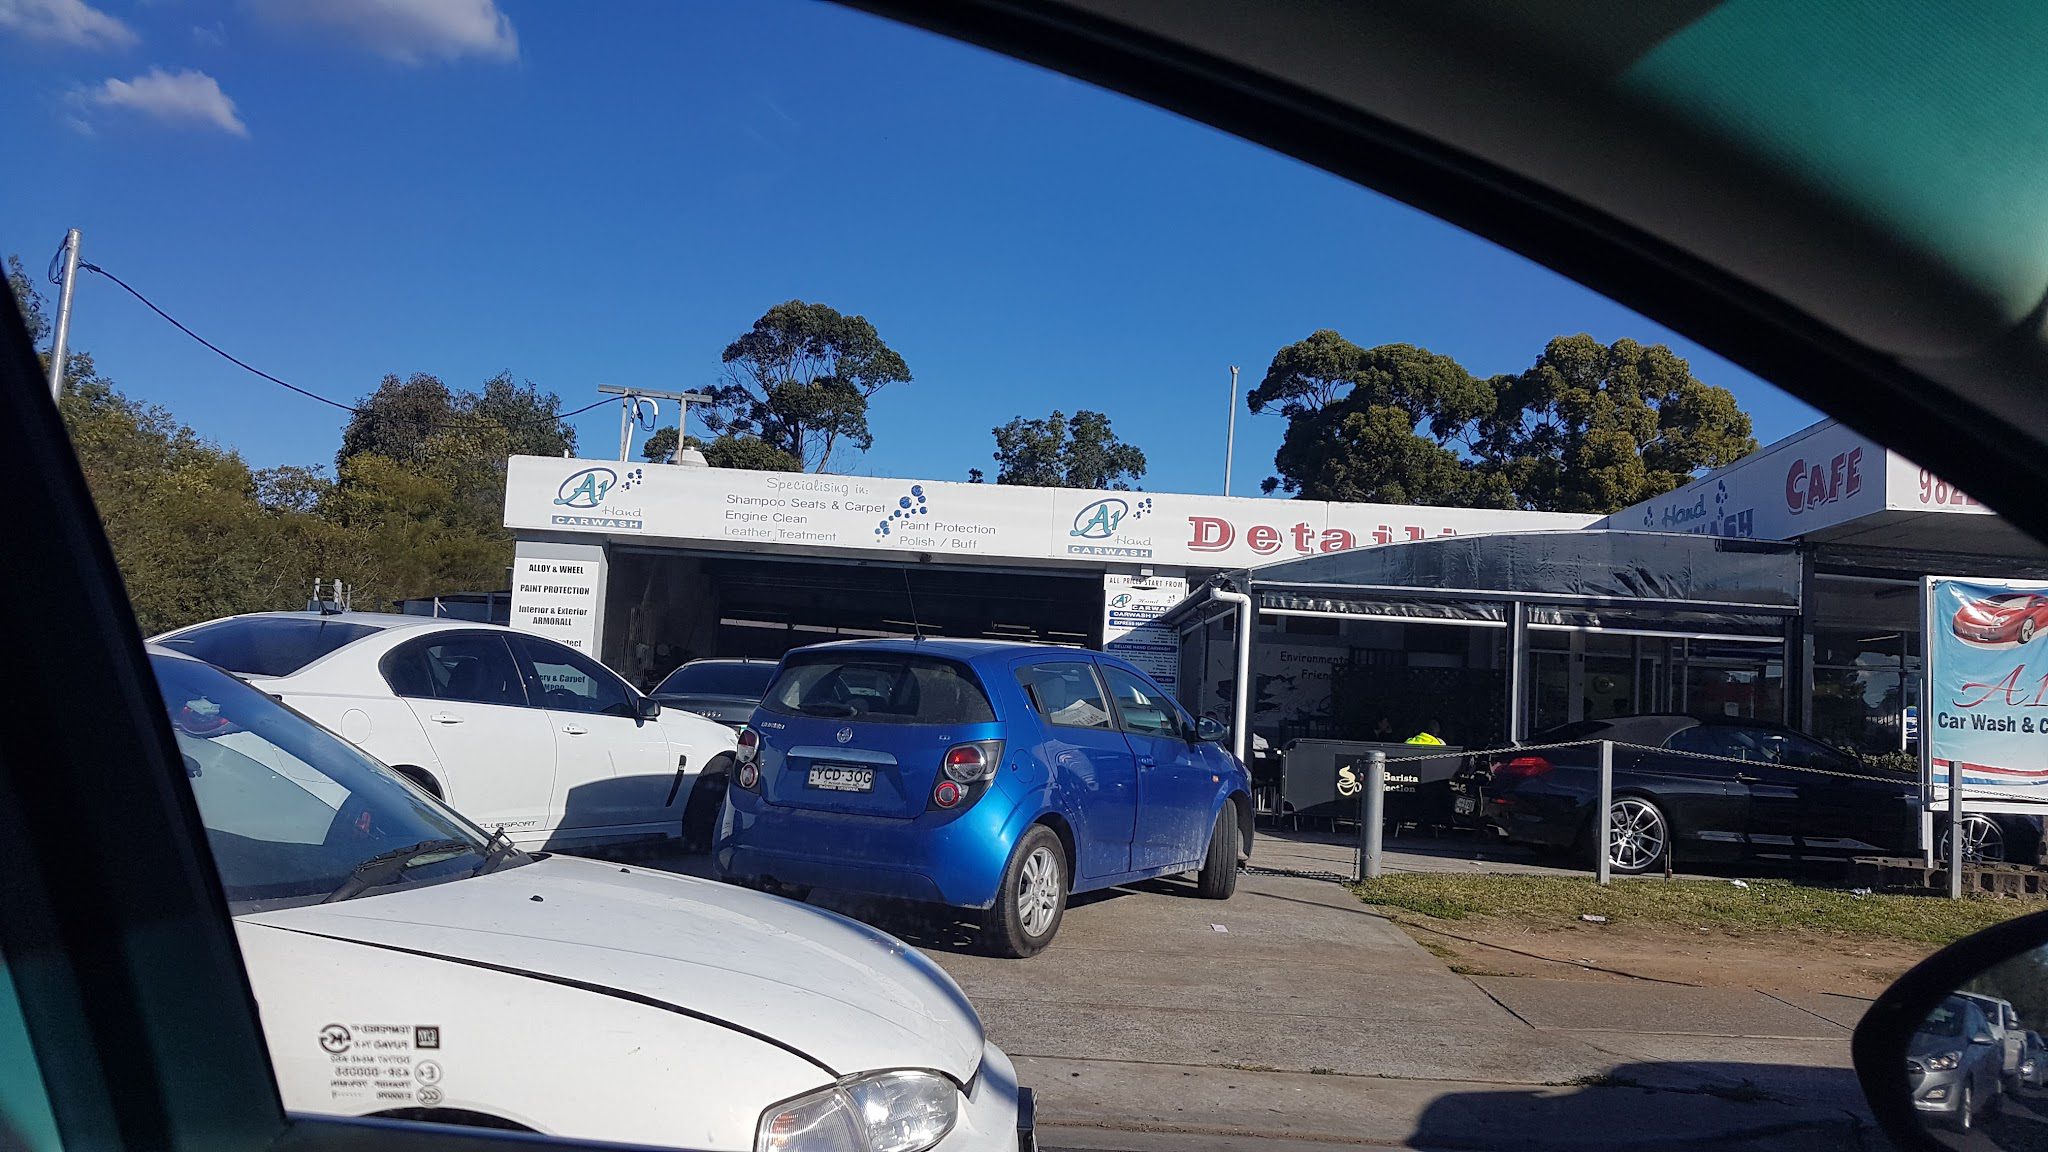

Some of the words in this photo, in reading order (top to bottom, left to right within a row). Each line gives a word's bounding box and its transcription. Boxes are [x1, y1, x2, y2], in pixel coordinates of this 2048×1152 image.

[766, 477, 849, 497] Specialising
[1786, 446, 1864, 515] CAFE
[1919, 467, 1980, 506] 982
[553, 472, 609, 506] A1
[726, 494, 786, 507] Shampoo
[790, 498, 826, 509] Seats
[831, 500, 840, 510] &
[844, 501, 886, 514] Carpet
[1662, 493, 1707, 528] Hand
[601, 505, 642, 517] Hand
[725, 509, 768, 523] Engine
[772, 512, 808, 523] Clean
[556, 516, 639, 529] CARWASH
[1069, 503, 1121, 536] A1
[724, 525, 772, 538] Leather
[777, 528, 837, 541] Treatment
[900, 520, 930, 531] Paint
[934, 522, 997, 535] Protection
[899, 535, 936, 547] Polish
[940, 538, 948, 548] /
[951, 538, 978, 549] Buff
[1115, 535, 1153, 546] Hand
[1071, 546, 1149, 557] CARWASH
[529, 564, 551, 573] ALLOY
[560, 565, 584, 574] WHEEL
[520, 584, 542, 593] PAINT
[543, 585, 590, 595] PROTECTION
[1165, 580, 1183, 588] FROM
[518, 605, 549, 614] Interior
[557, 607, 588, 616] Exterior
[1113, 610, 1151, 618] CARWASH
[532, 617, 572, 626] ARMORALL
[1280, 650, 1346, 664] Environment
[560, 674, 586, 683] Carpet
[1301, 668, 1329, 680] Frien
[1938, 711, 1966, 730] Car
[1971, 713, 2016, 732] Wash
[2022, 716, 2035, 733] &
[1383, 772, 1419, 783] Barista
